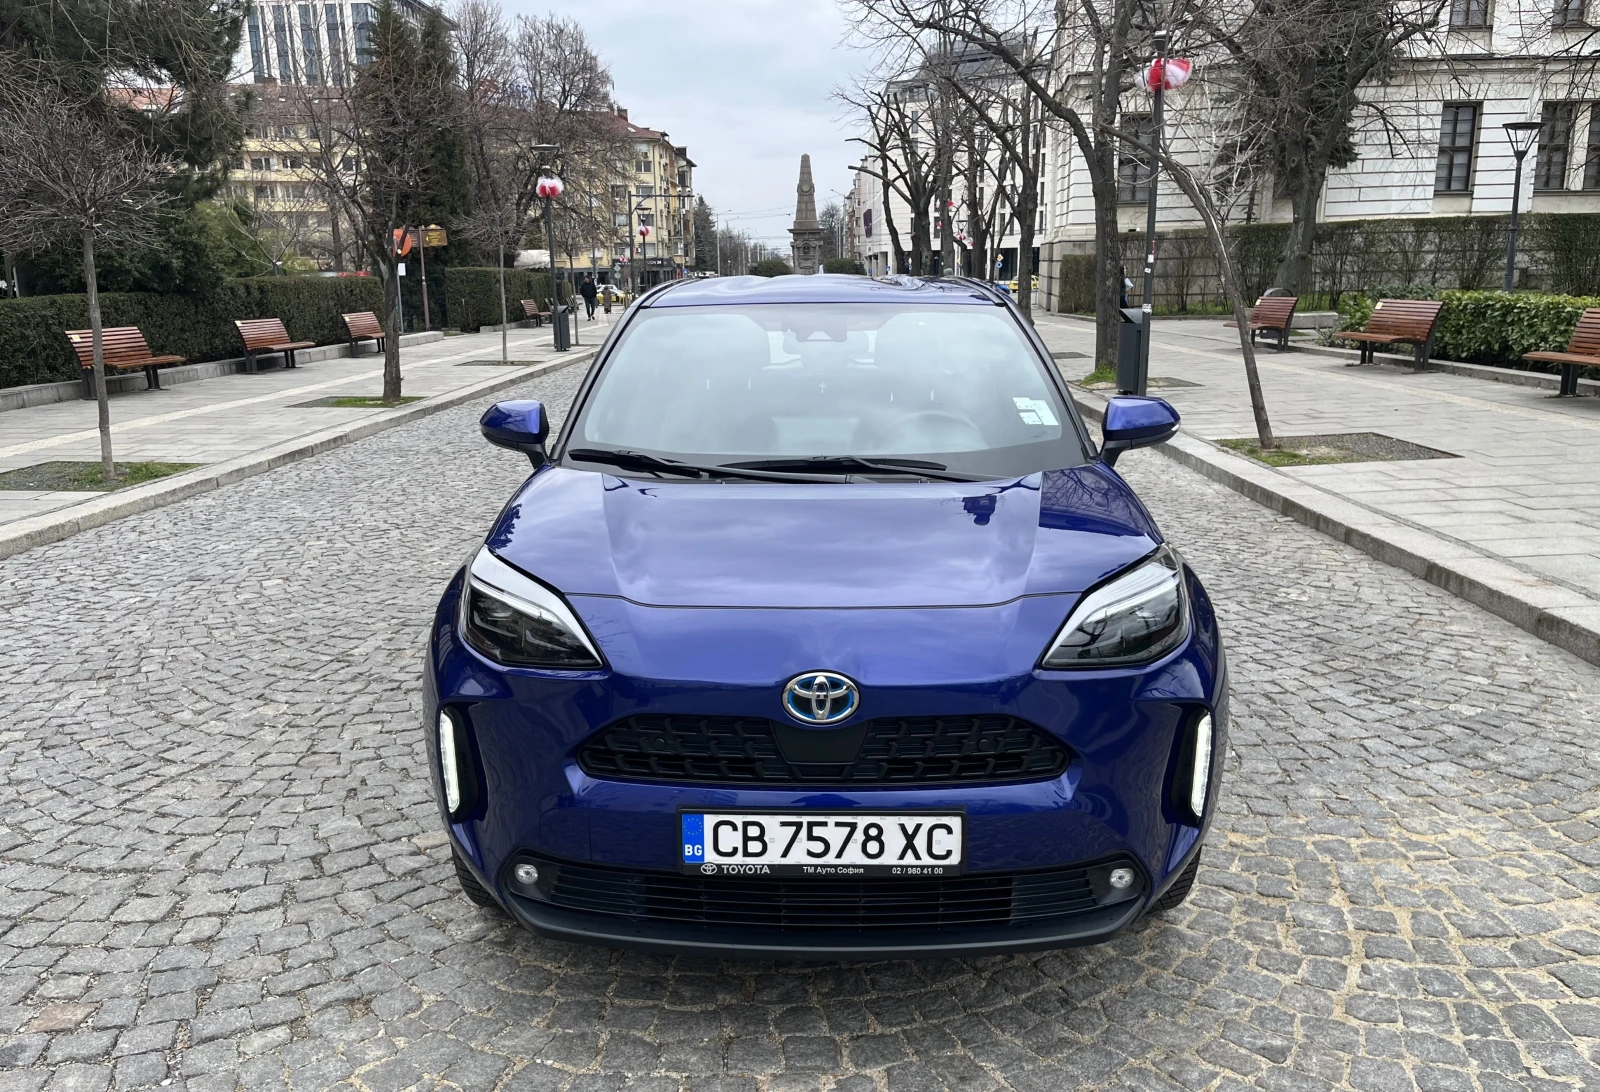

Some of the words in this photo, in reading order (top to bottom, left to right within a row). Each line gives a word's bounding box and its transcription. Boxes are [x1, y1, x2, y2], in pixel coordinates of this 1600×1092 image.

[712, 820, 768, 858] CB
[779, 821, 885, 859] 7578
[897, 823, 954, 861] XC
[684, 845, 703, 856] BG
[721, 864, 771, 875] TOYOTA
[816, 866, 835, 875] Ауто
[837, 866, 864, 875] София
[907, 867, 921, 875] 960
[923, 867, 932, 875] 41
[934, 867, 943, 875] 00
